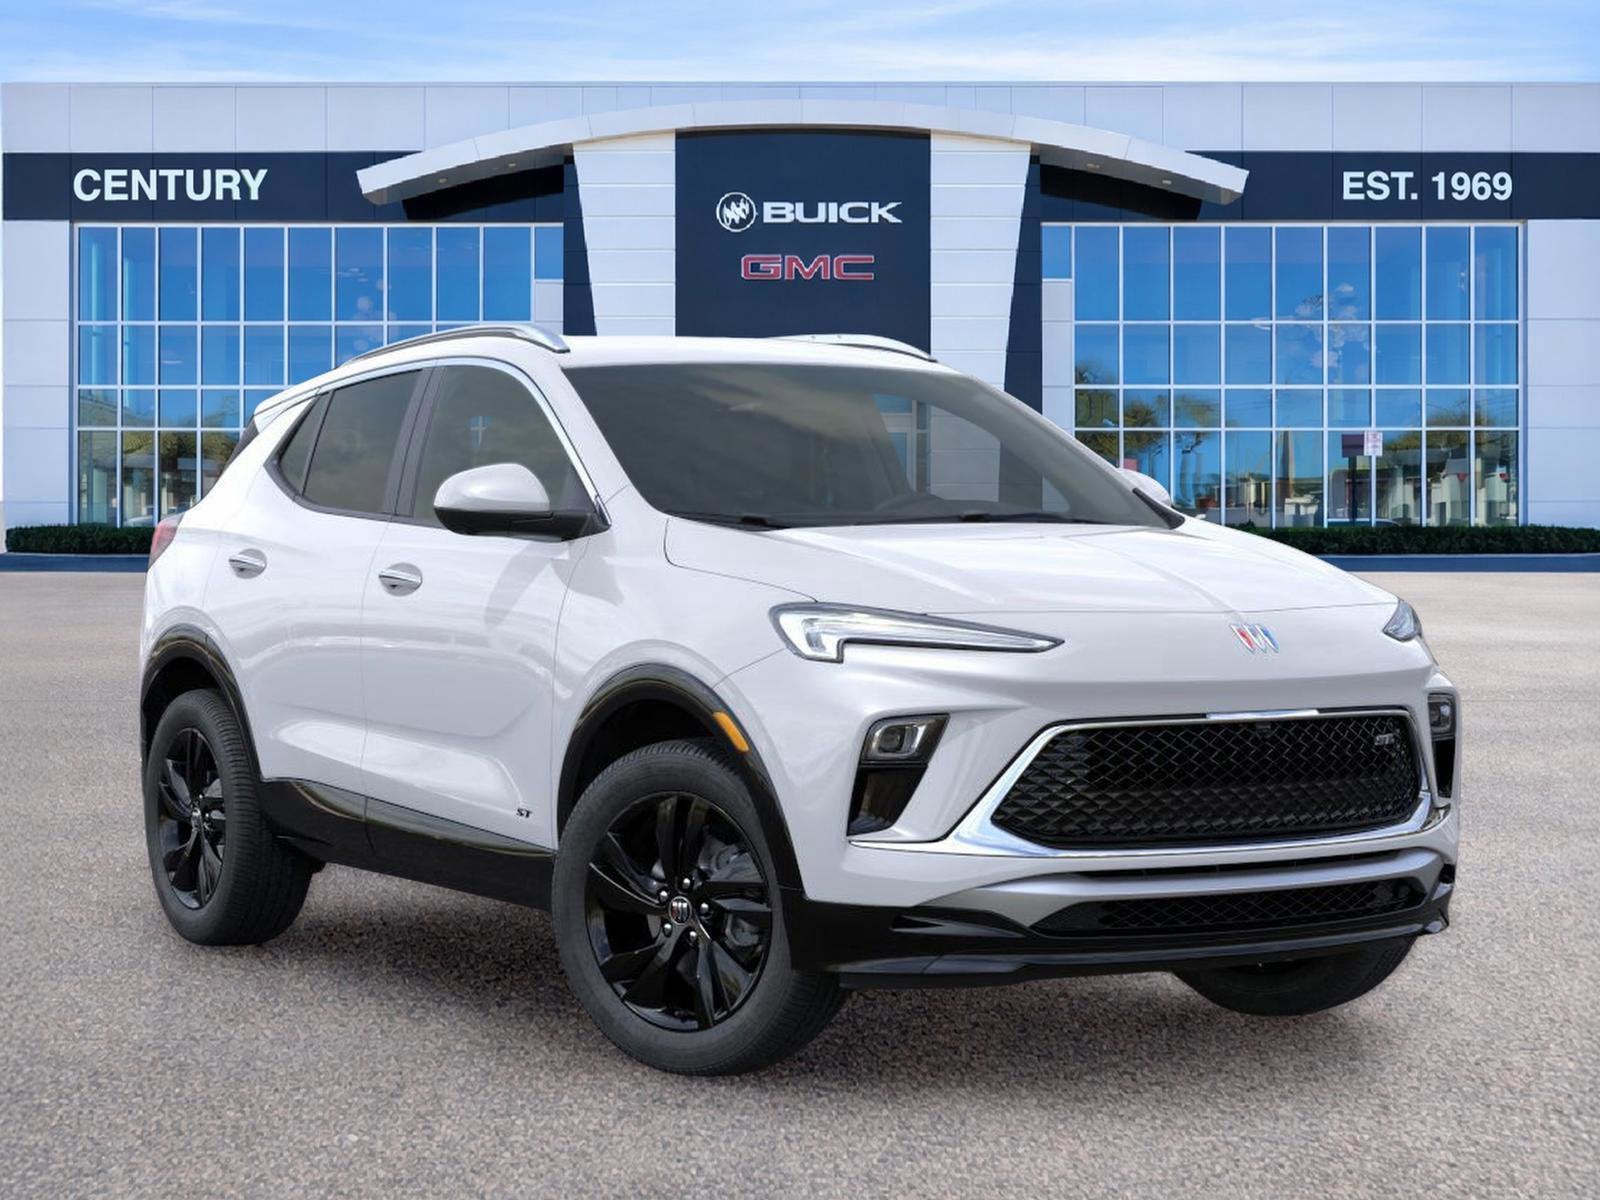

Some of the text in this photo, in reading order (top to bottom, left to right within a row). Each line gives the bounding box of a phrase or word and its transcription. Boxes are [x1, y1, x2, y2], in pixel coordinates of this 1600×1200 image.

[73, 168, 268, 202] CENTURY
[1342, 170, 1513, 202] EST. 1969
[762, 201, 902, 225] BUICK
[740, 253, 875, 281] GMC
[516, 808, 533, 819] ST
